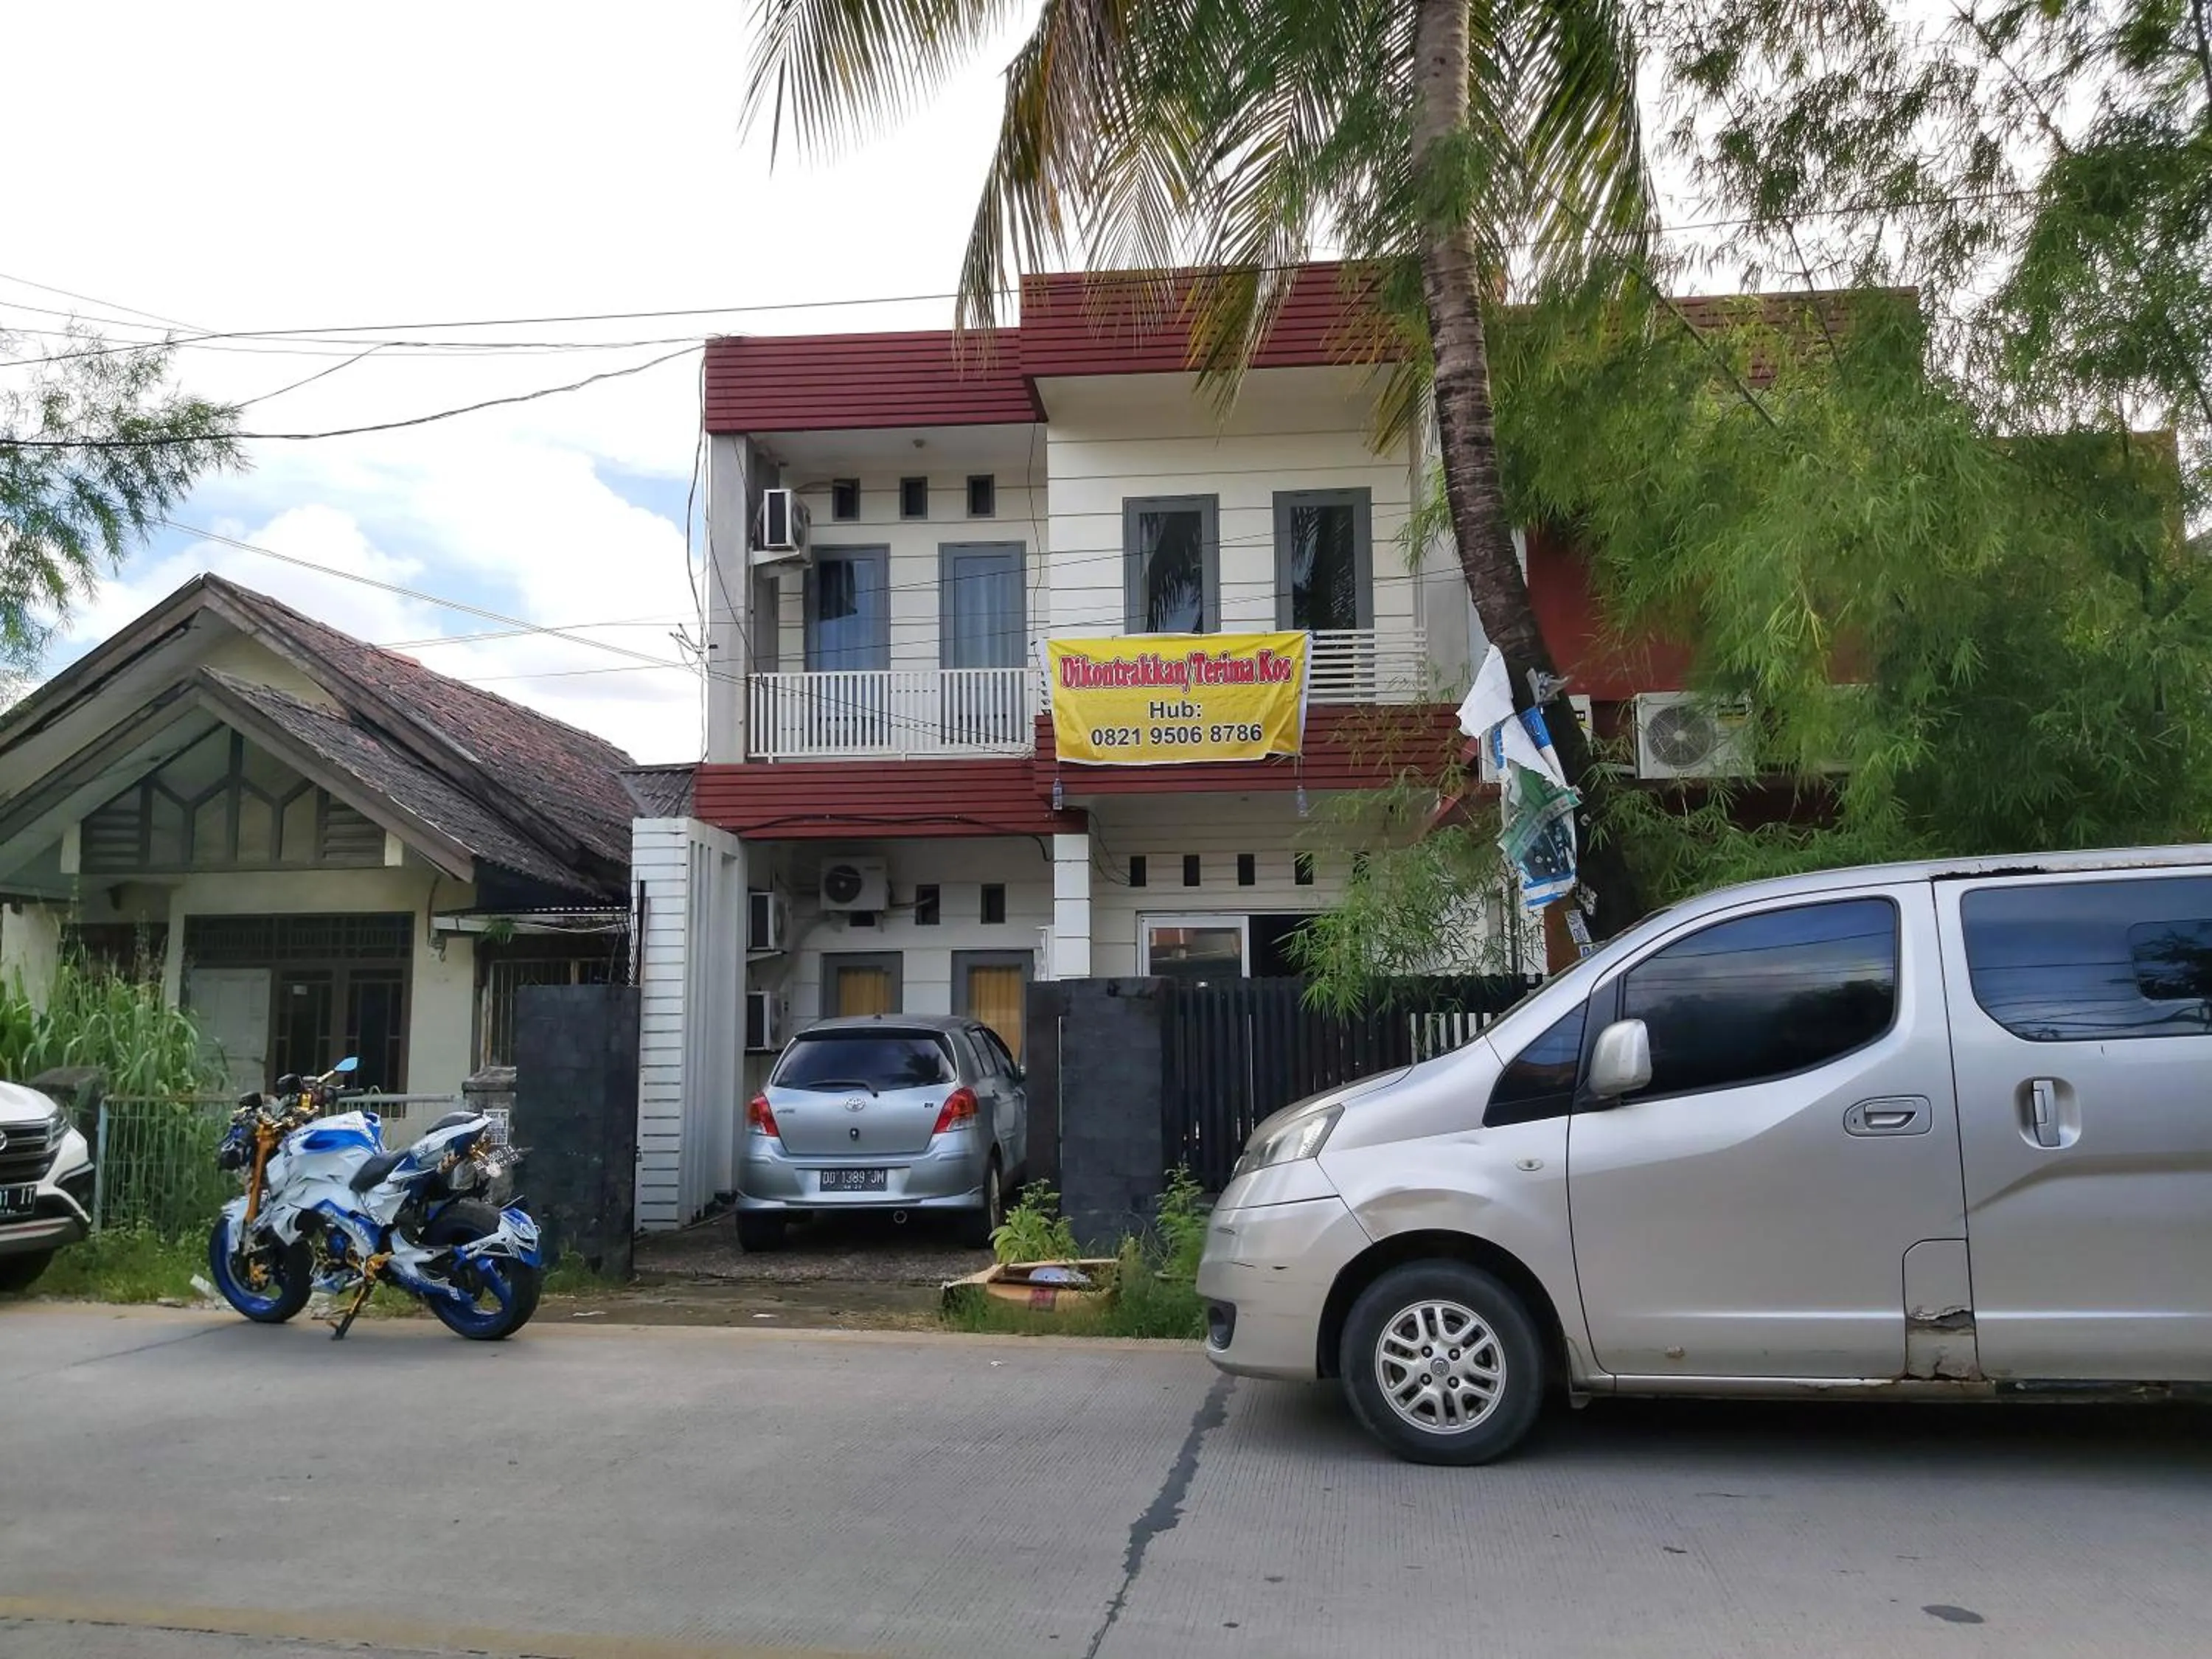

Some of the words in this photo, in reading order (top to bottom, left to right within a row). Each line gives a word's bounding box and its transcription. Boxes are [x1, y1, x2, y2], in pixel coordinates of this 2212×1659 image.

[1256, 649, 1292, 684] Kos
[1149, 700, 1203, 720] Hub:
[1091, 728, 1141, 746] 0821
[1150, 726, 1203, 745] 9506
[1210, 723, 1263, 742] 8786
[841, 1170, 865, 1183] 1389
